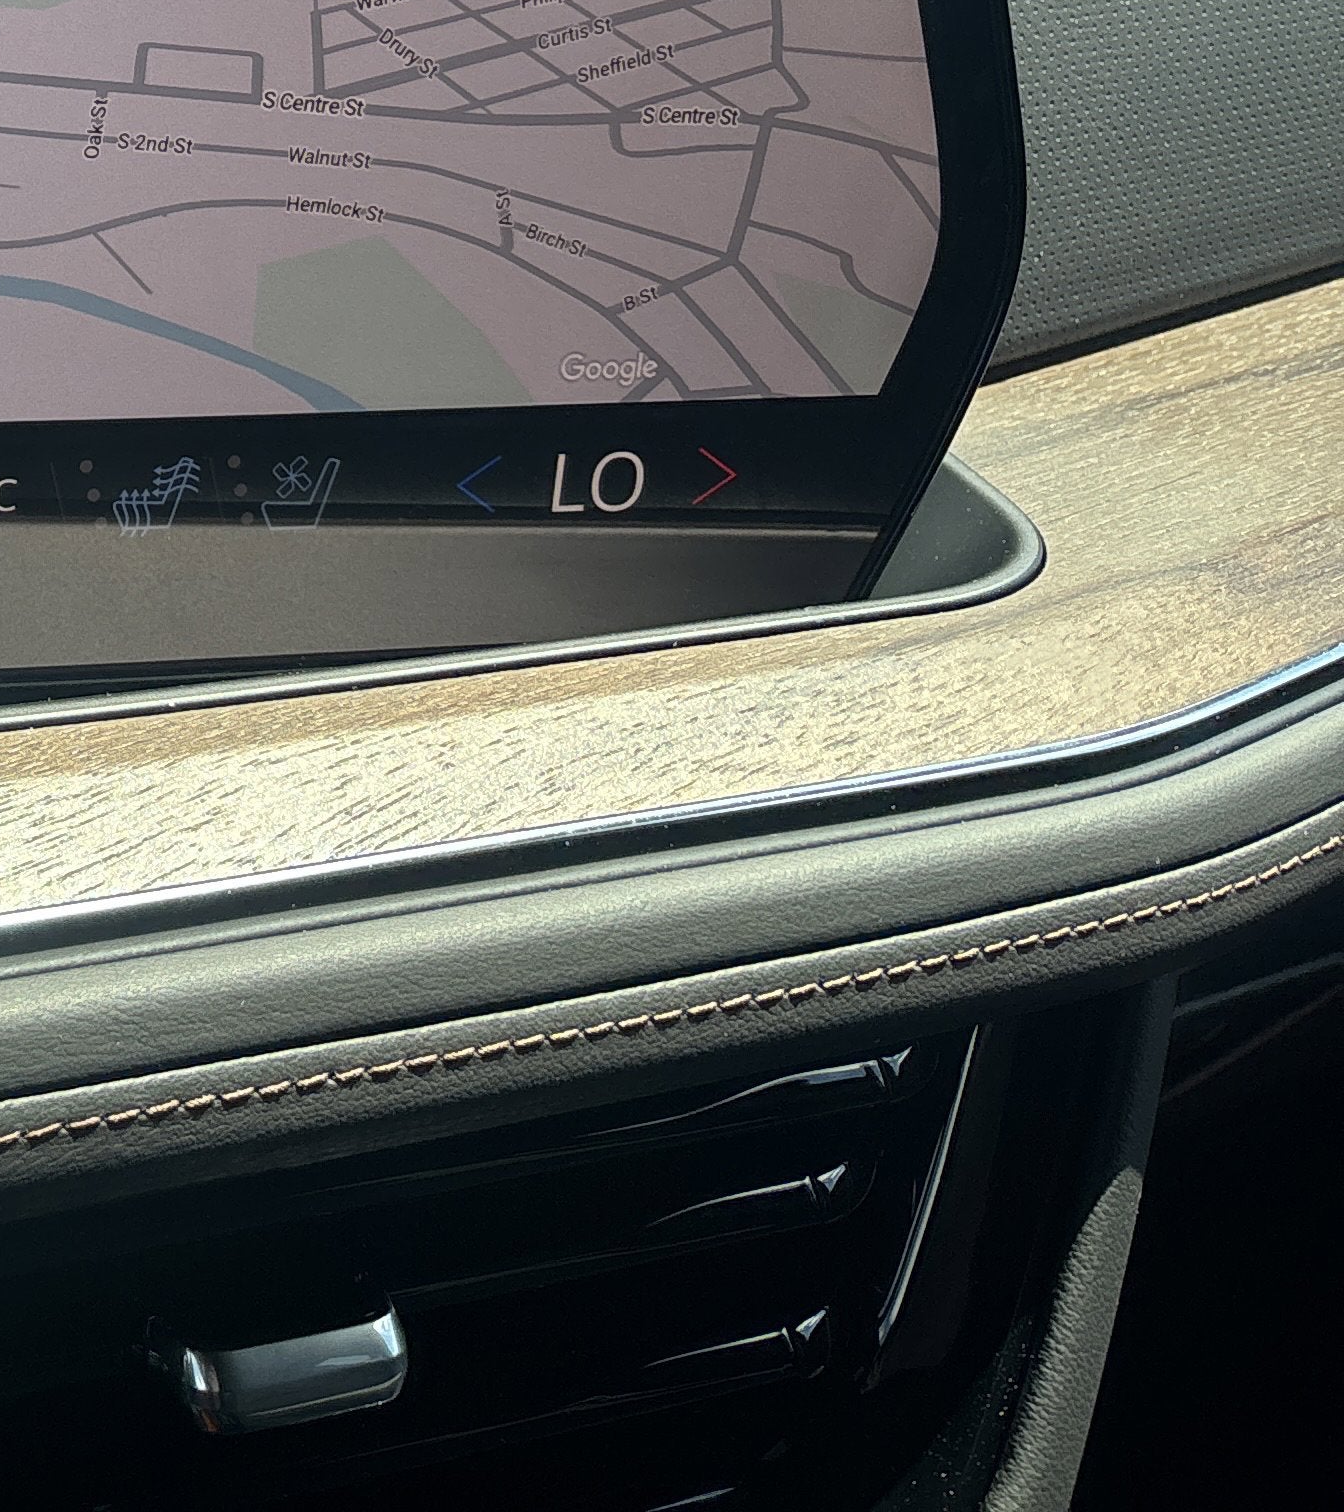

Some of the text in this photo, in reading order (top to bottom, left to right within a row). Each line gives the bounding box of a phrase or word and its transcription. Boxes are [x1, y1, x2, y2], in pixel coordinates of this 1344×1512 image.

[538, 19, 612, 49] Curtis St
[577, 46, 674, 82] Sheffield St
[263, 92, 364, 116] S Centre St
[643, 107, 738, 125] S Centre St
[288, 147, 370, 168] Walnut St
[287, 197, 384, 223] Hemlock St
[496, 189, 510, 210] St
[526, 224, 587, 258] Birch St
[624, 287, 658, 311] B St
[561, 352, 658, 382] Google
[550, 450, 647, 514] LO
